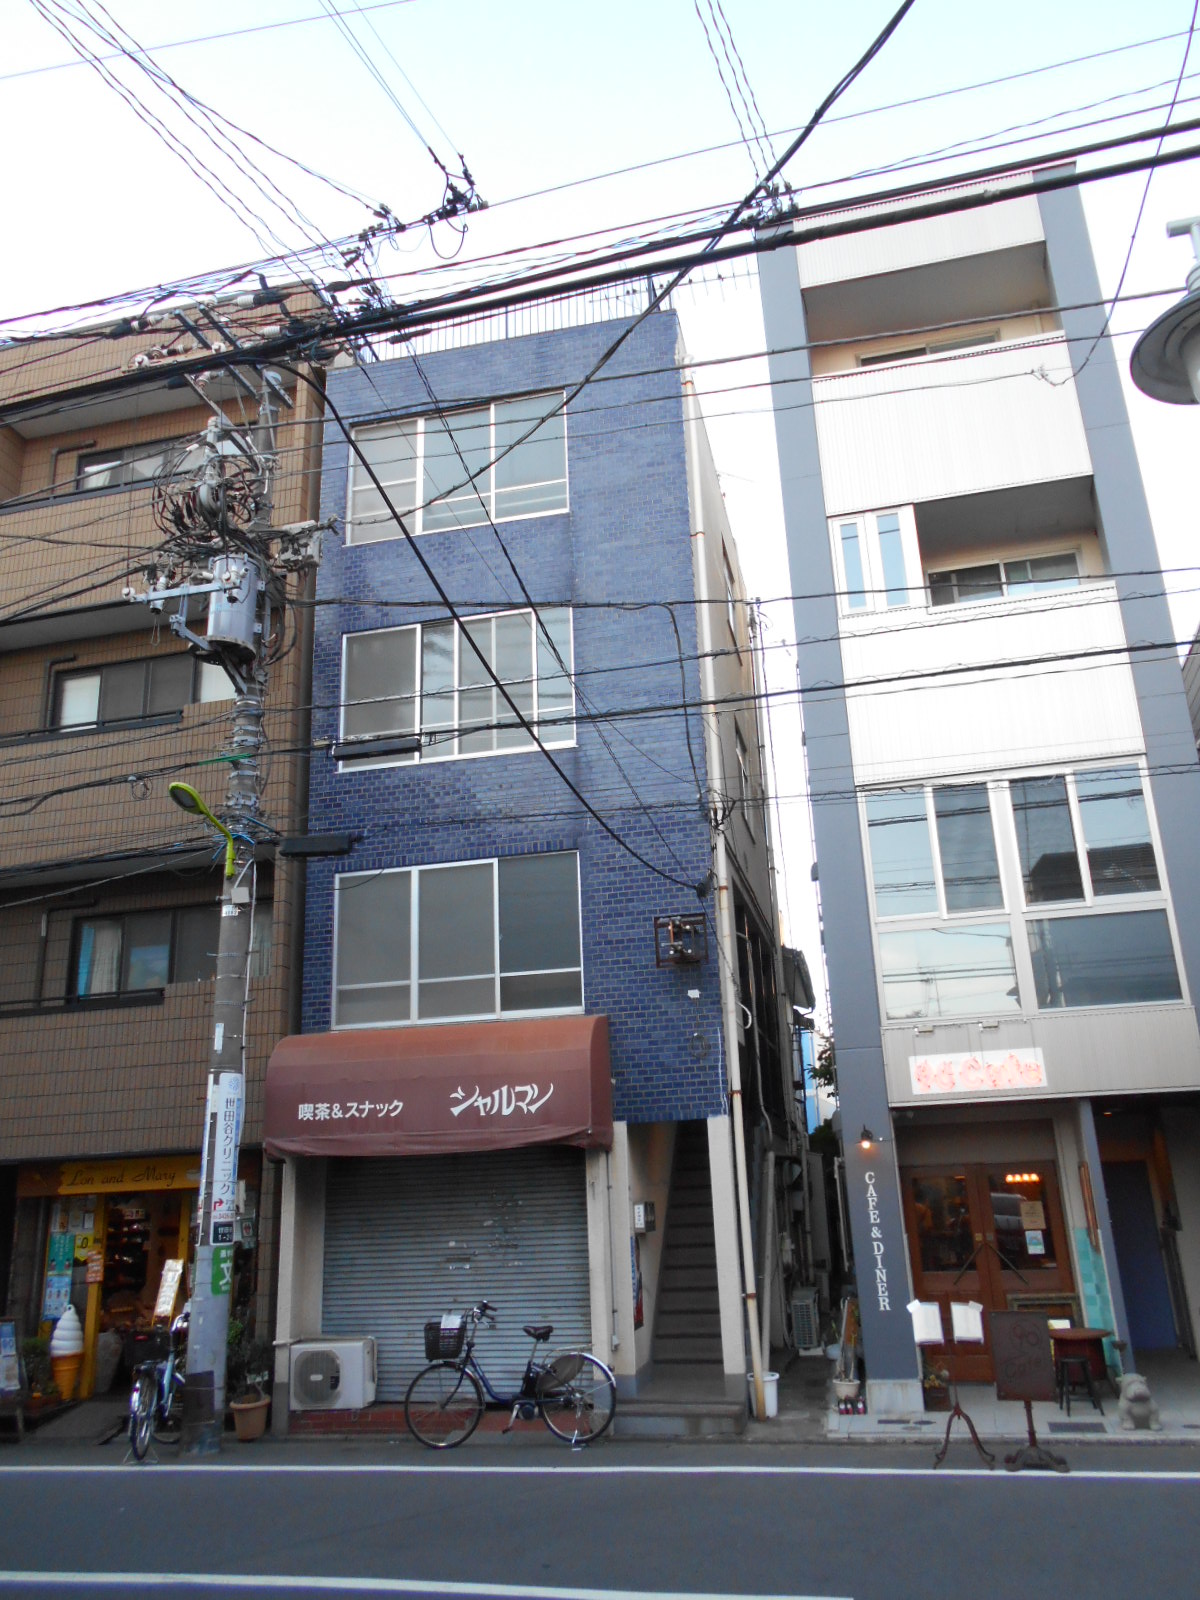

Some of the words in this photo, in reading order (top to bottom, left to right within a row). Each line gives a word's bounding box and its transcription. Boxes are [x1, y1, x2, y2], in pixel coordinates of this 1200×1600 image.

[298, 1099, 404, 1121] 喫茶&スナック
[449, 1082, 554, 1117] シャルマン
[220, 1097, 236, 1196] 世田谷クリニック
[101, 1171, 124, 1185] and
[133, 1166, 176, 1188] Mary
[864, 1171, 880, 1224] CAFE
[870, 1226, 883, 1238] &
[873, 1240, 891, 1311] DINER
